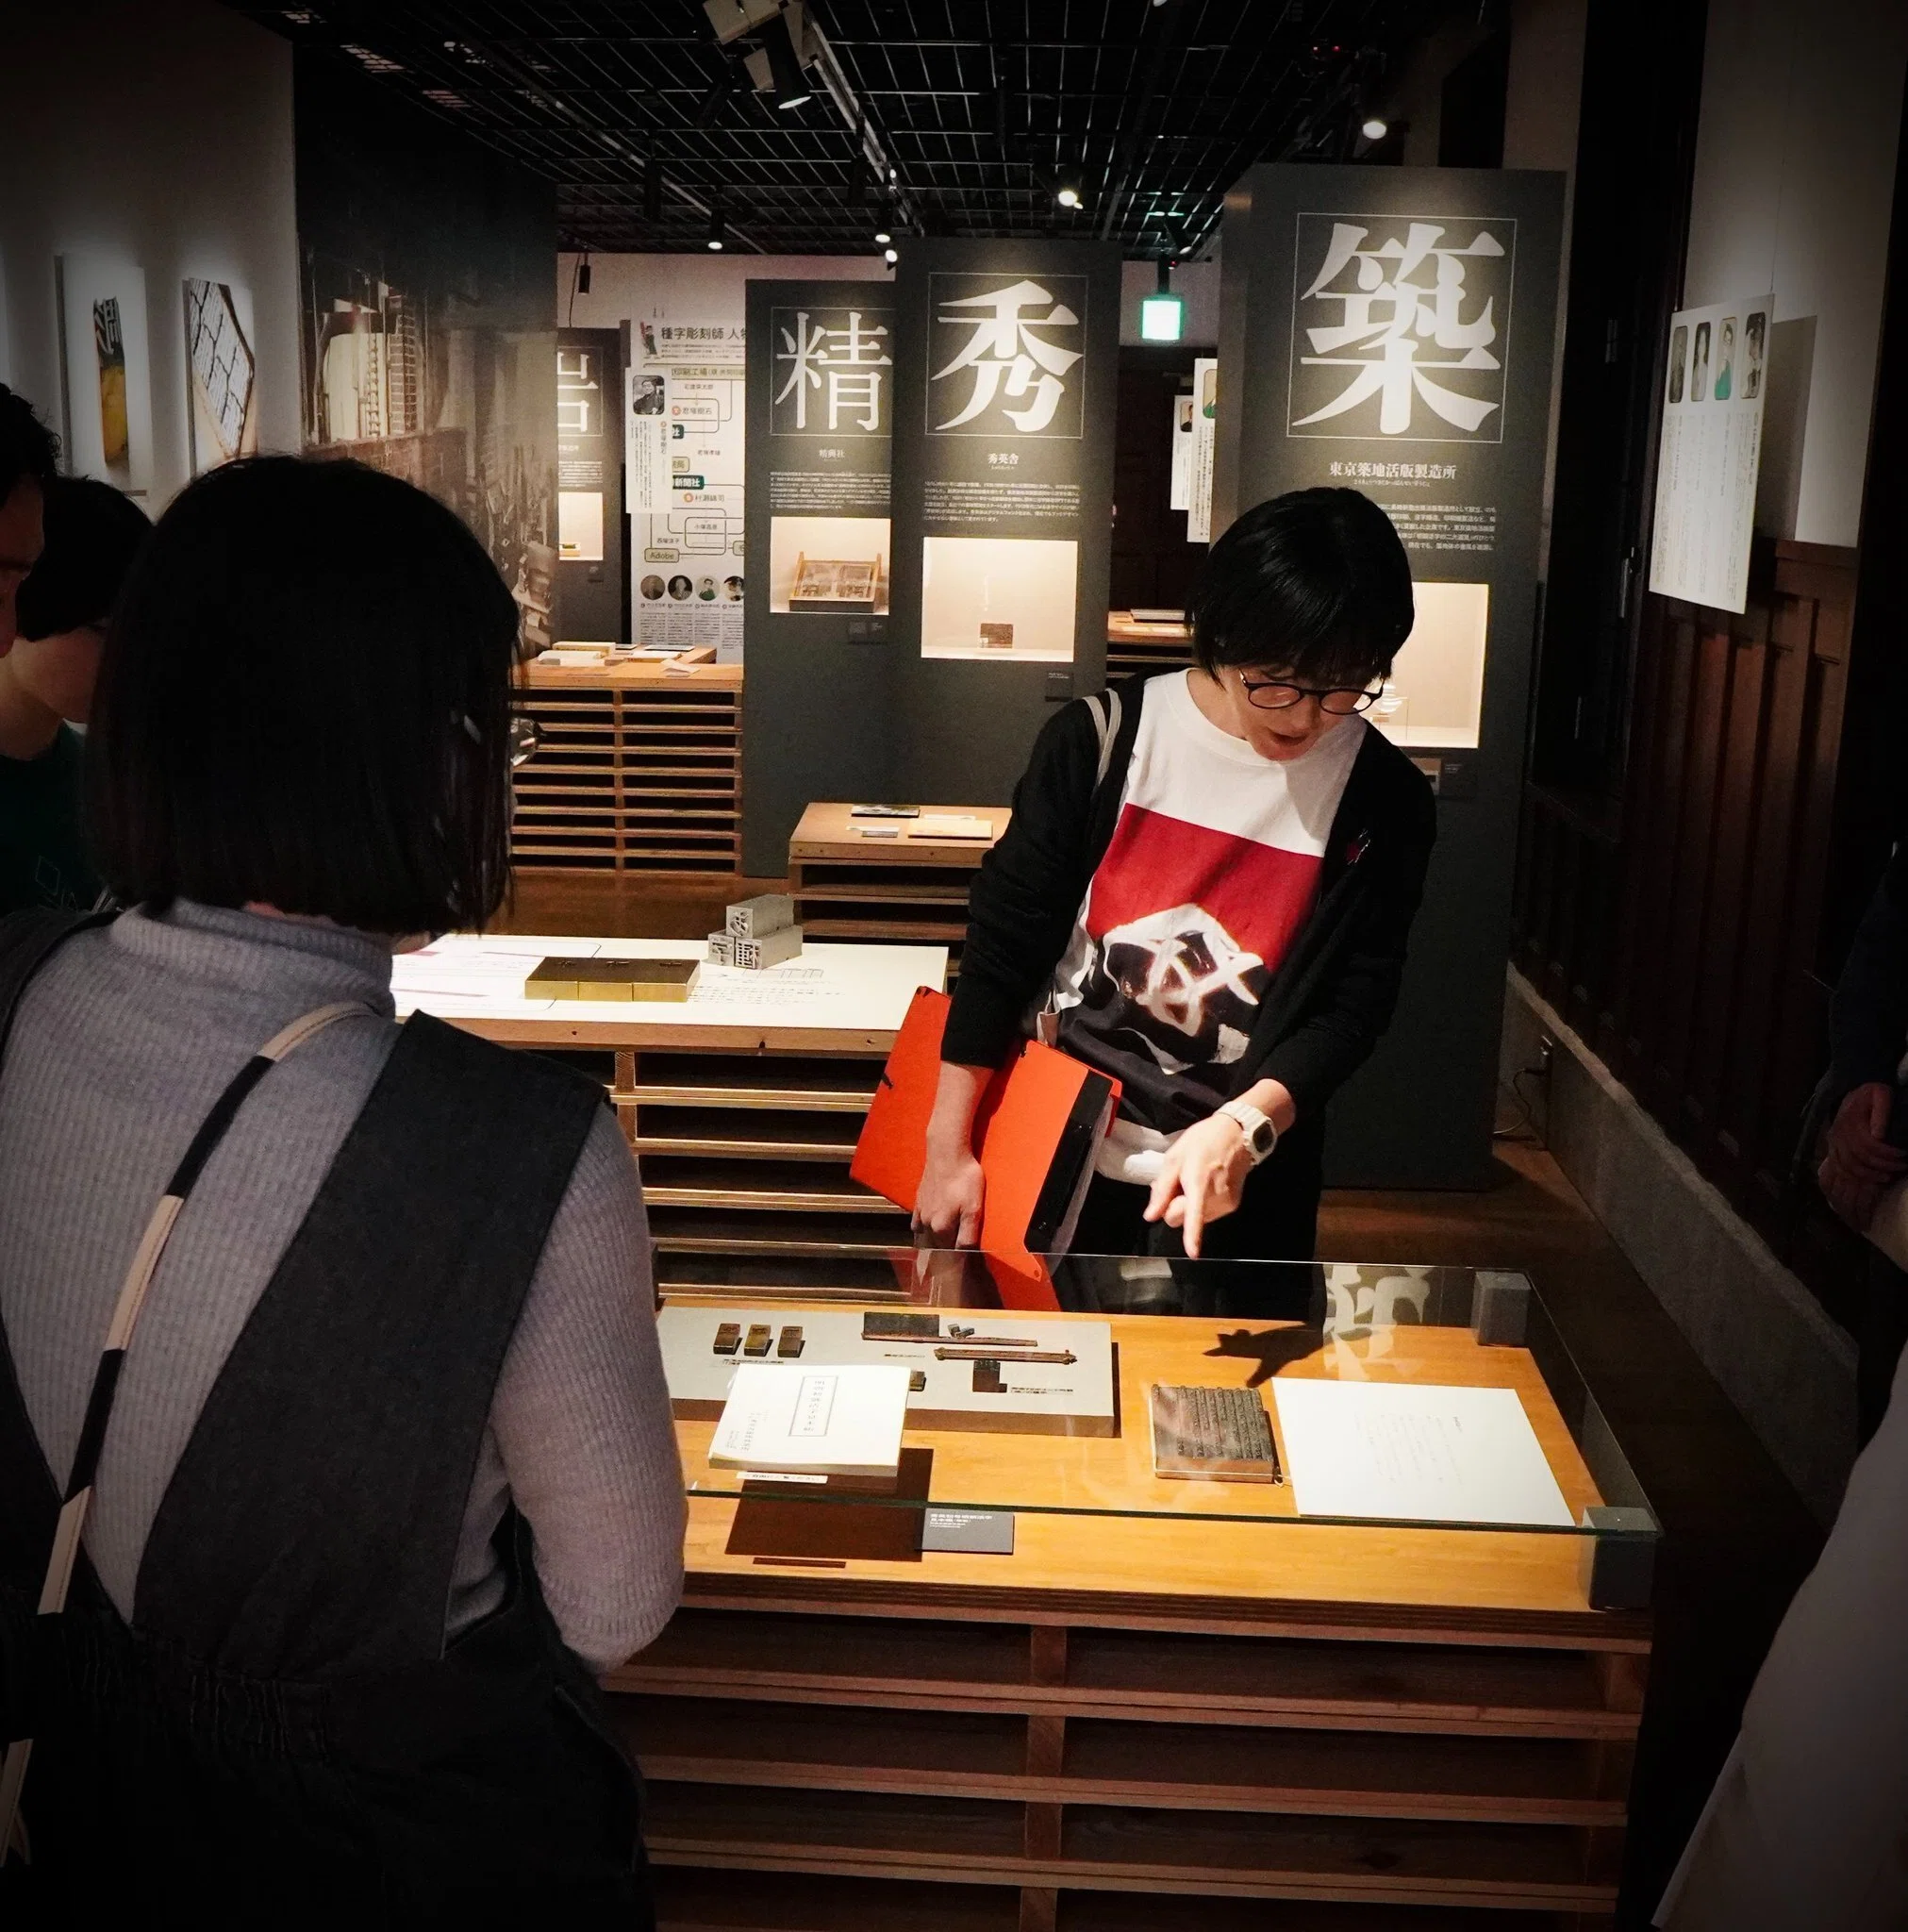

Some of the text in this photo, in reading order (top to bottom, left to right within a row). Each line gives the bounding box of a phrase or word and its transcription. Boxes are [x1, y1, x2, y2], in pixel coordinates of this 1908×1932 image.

[775, 312, 892, 430] 精
[931, 280, 1083, 432] 秀
[1292, 223, 1505, 434] 築
[1330, 461, 1456, 479] 東京築地活版製造所
